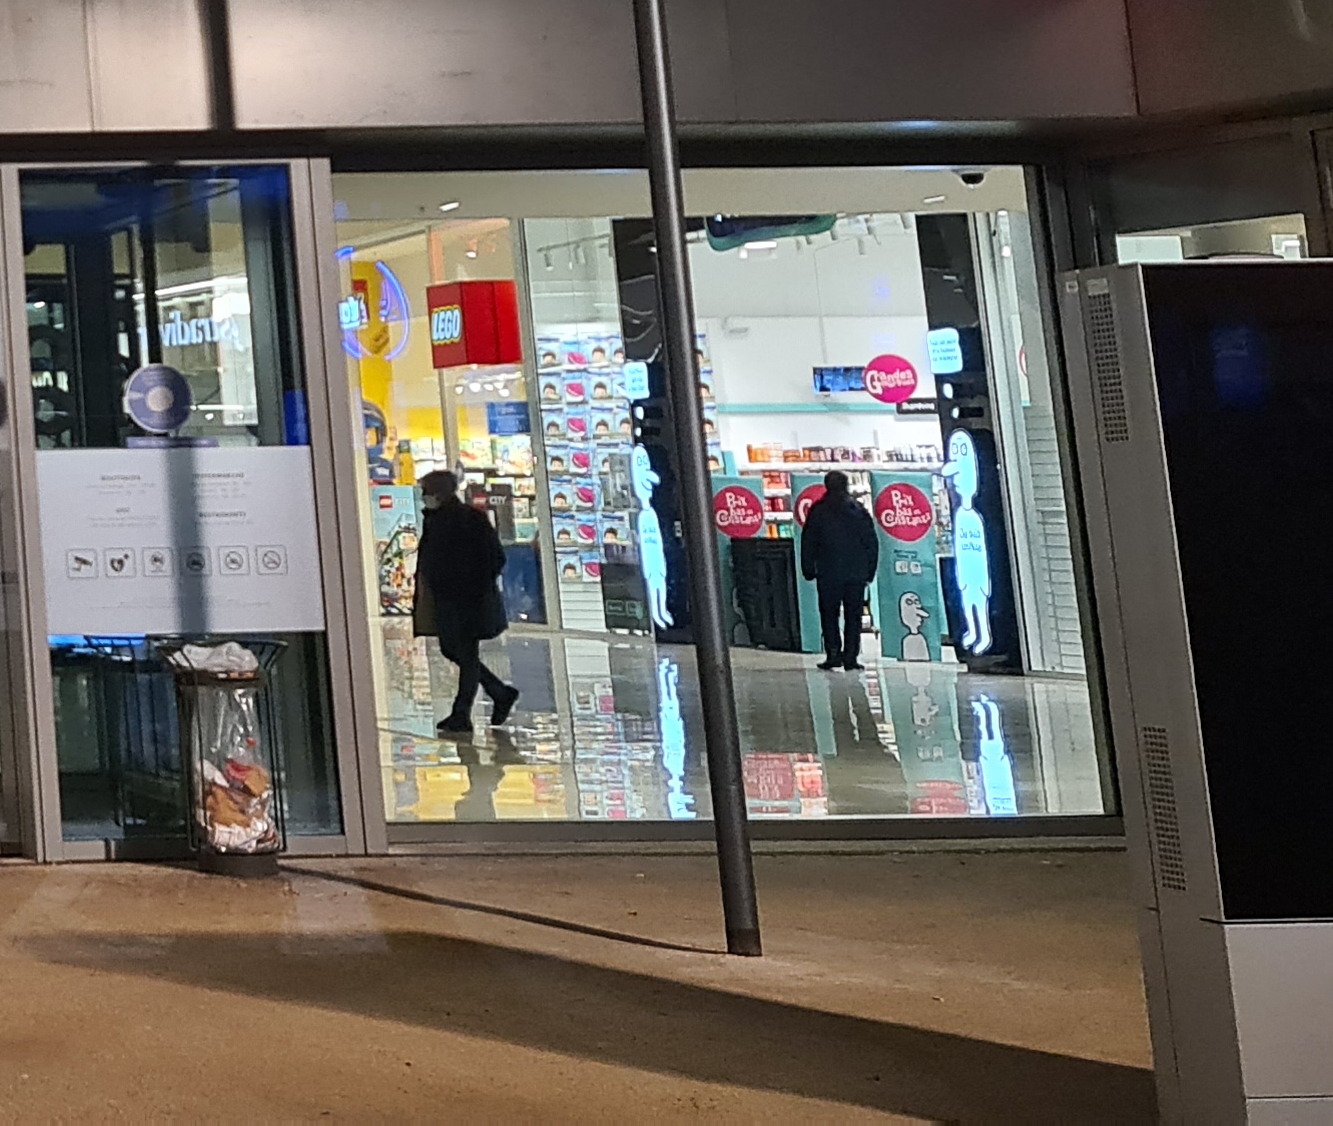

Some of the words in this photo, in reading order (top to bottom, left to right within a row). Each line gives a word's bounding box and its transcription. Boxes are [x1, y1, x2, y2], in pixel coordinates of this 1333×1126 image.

[431, 305, 462, 344] LEGO
[725, 491, 748, 508] Prix
[890, 489, 914, 507] Prix
